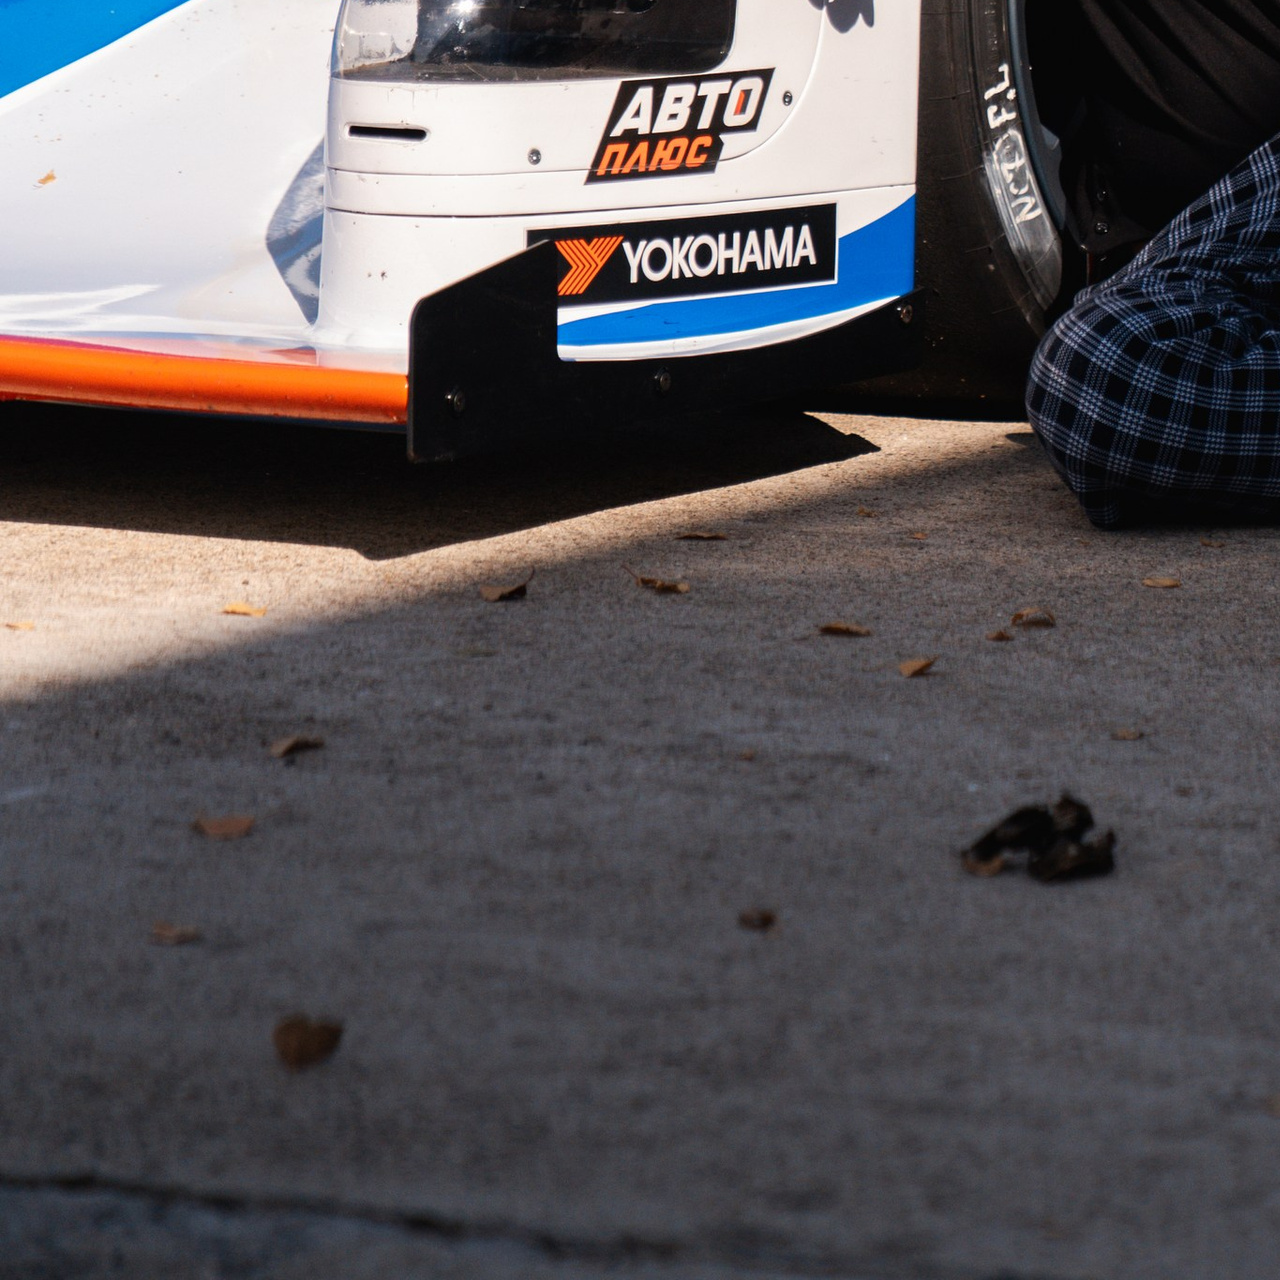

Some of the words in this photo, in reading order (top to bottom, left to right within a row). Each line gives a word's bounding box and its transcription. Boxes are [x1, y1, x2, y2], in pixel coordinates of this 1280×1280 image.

[609, 75, 764, 138] АВТО
[596, 135, 713, 176] ПЛЮС
[622, 223, 818, 284] YOKOHAMA
